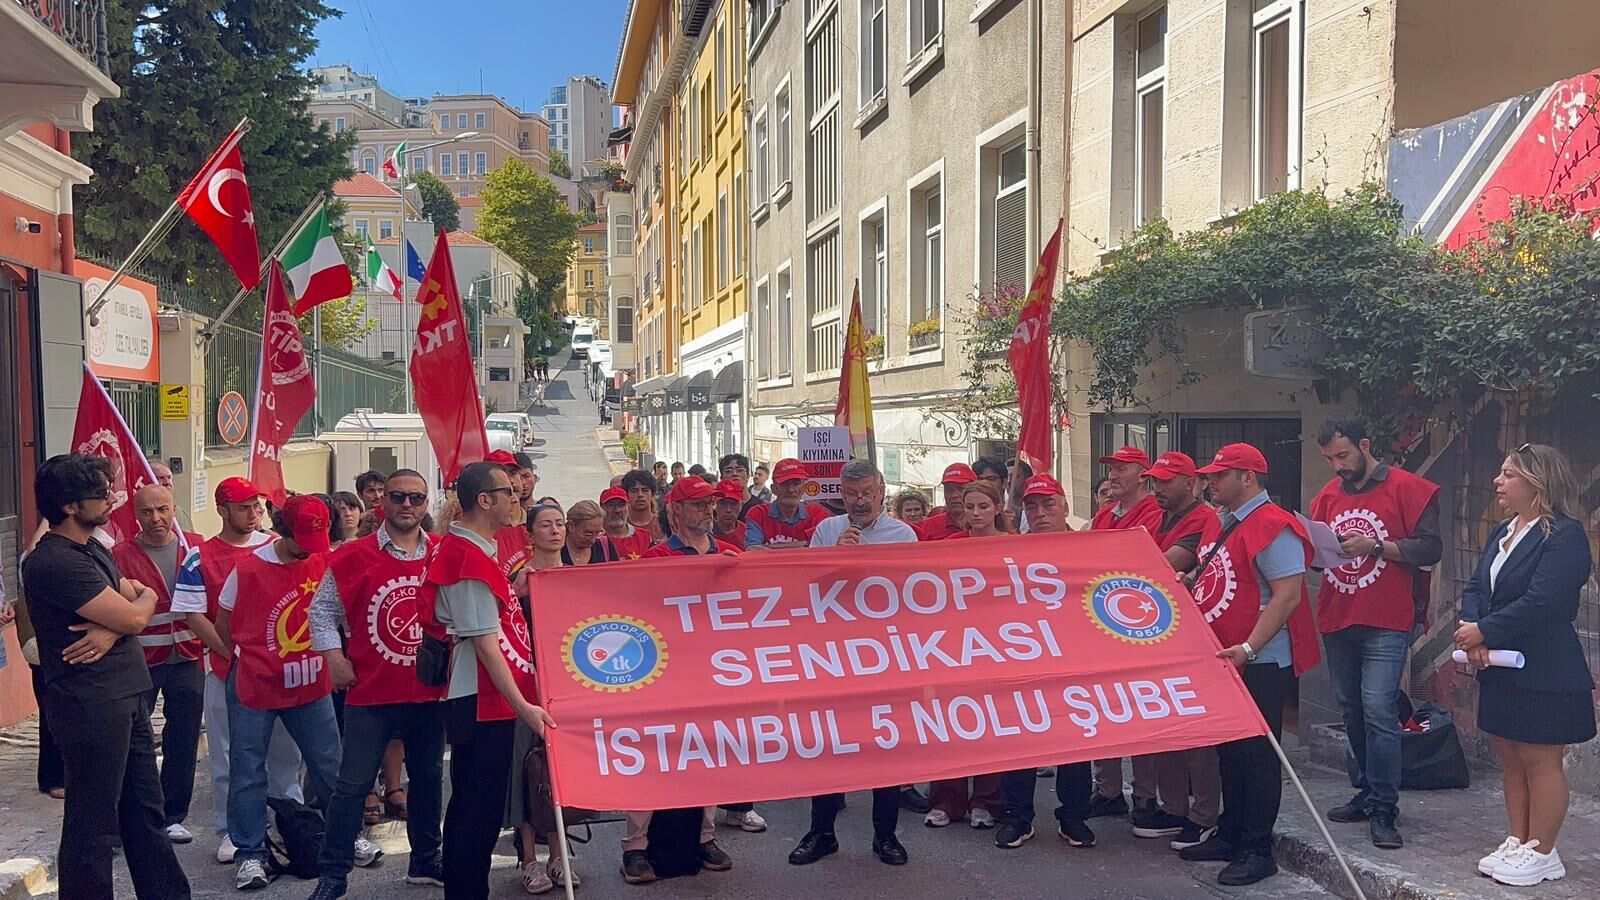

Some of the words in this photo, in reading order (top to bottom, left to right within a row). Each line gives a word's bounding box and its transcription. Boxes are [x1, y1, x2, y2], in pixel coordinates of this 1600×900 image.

[270, 326, 302, 354] TİP
[814, 430, 831, 447] İŞÇİ
[803, 449, 845, 460] KIYIMINA
[664, 558, 1067, 634] TEZ-KOOP-İŞ
[1126, 626, 1163, 638] 1952
[611, 655, 632, 671] tk
[711, 619, 1063, 687] SENDİKASI
[283, 654, 323, 689] DİP
[605, 674, 634, 684] 1962
[594, 709, 861, 780] İSTANBUL
[872, 704, 900, 750] 5
[911, 688, 1052, 745] NOLU
[1062, 676, 1207, 738] ŞUBE
